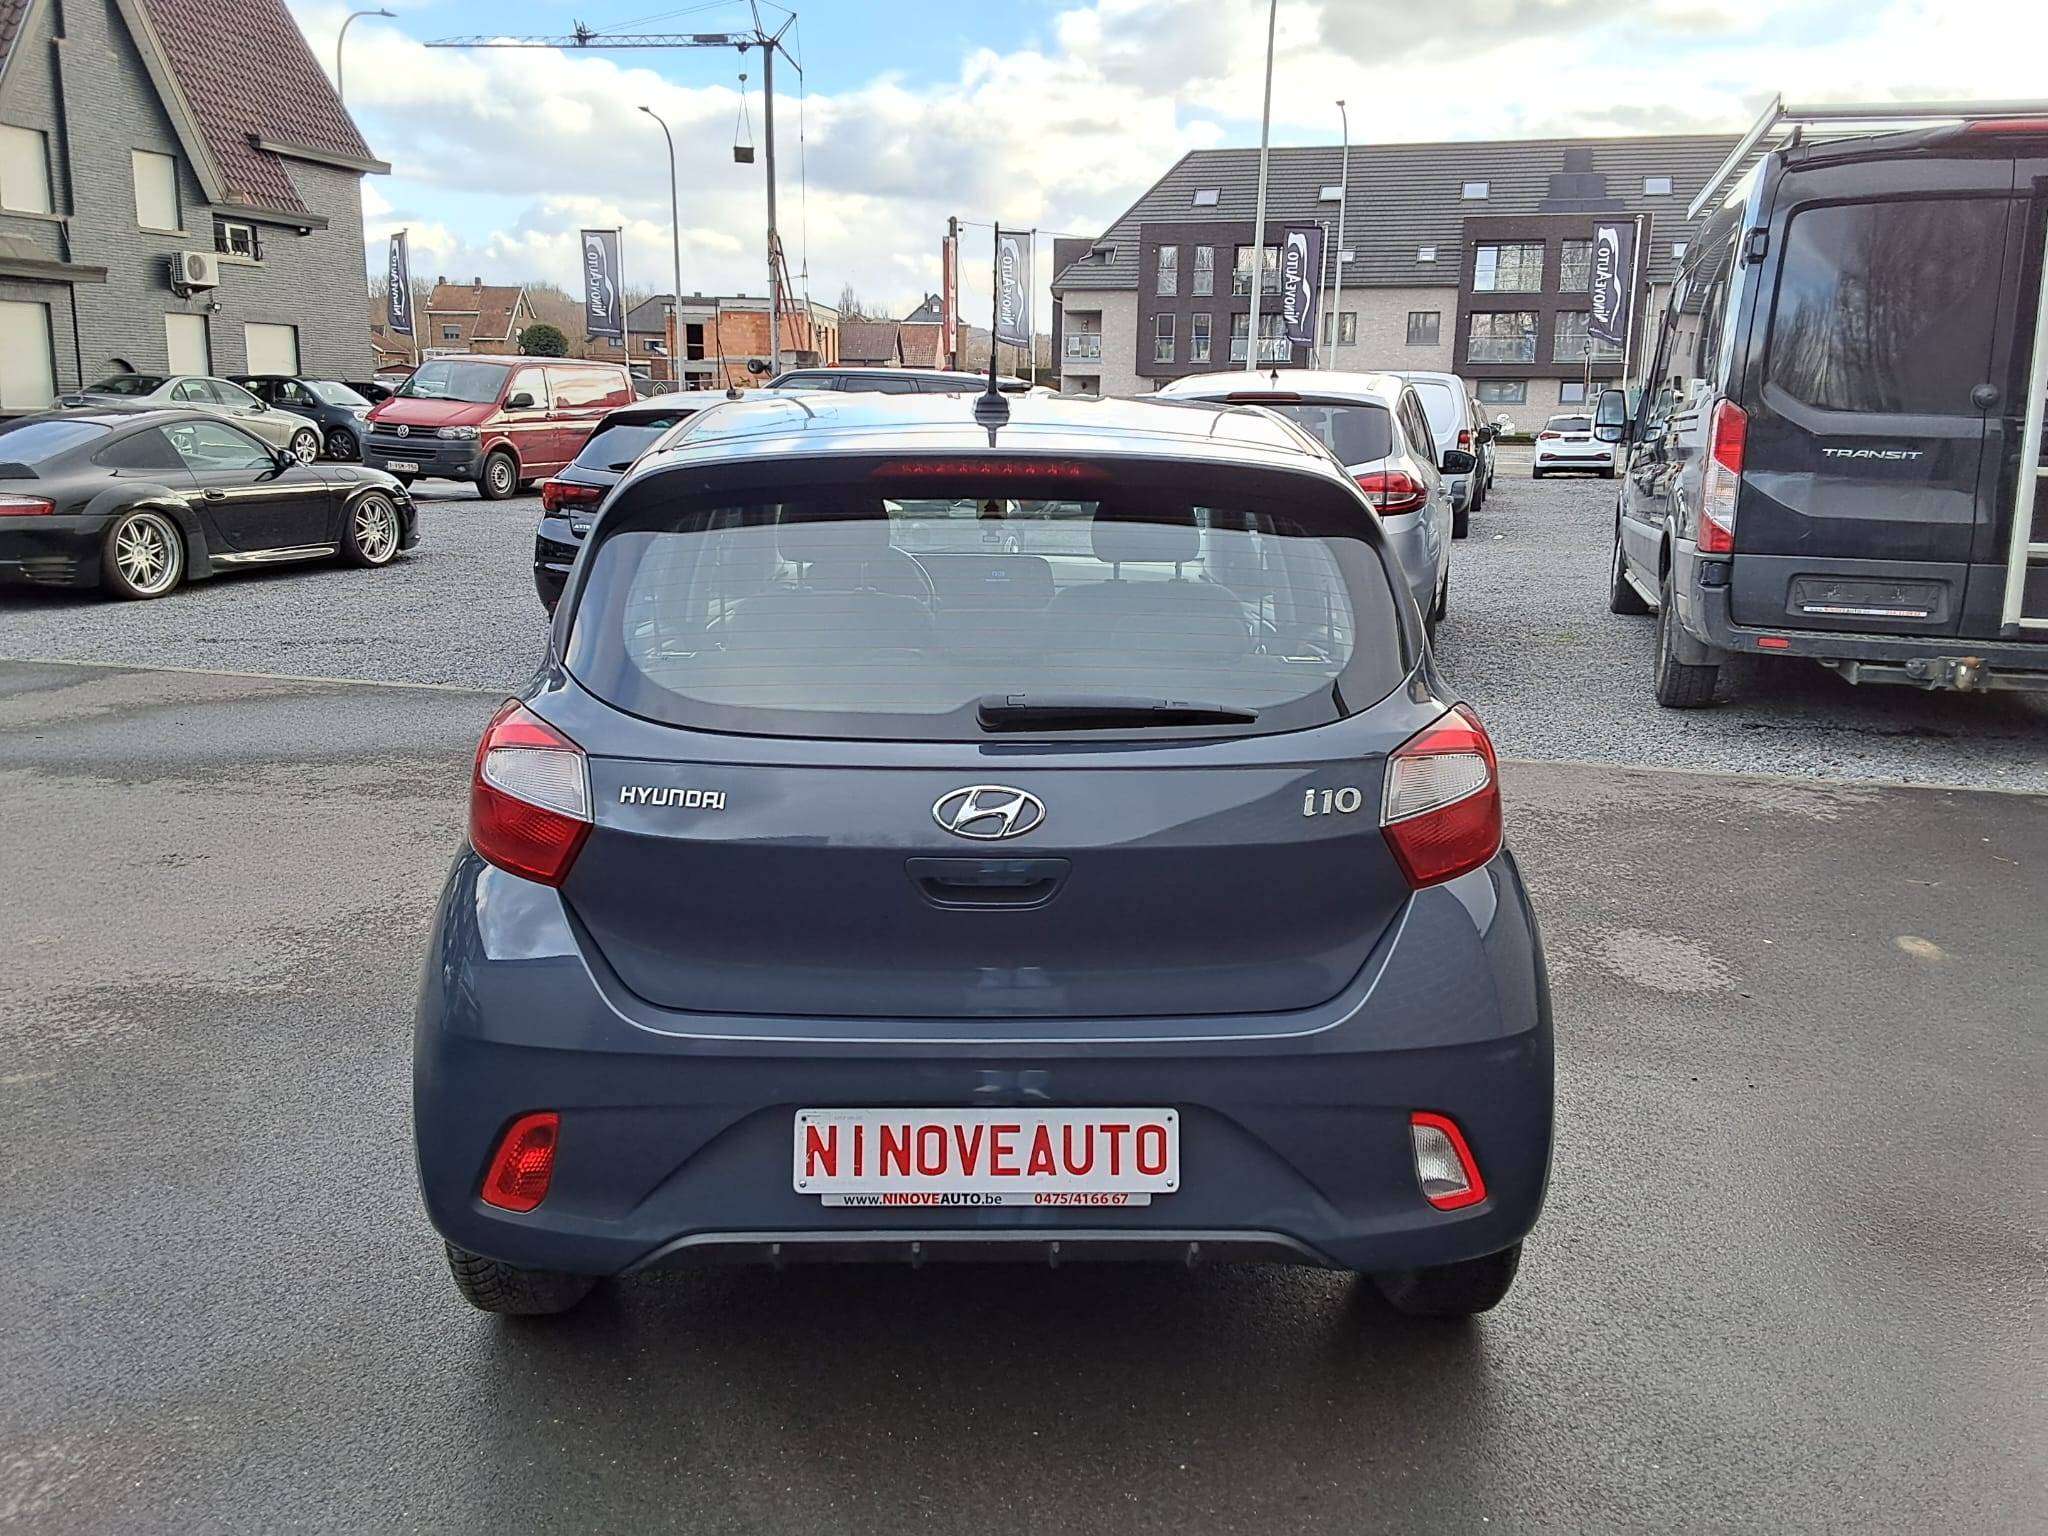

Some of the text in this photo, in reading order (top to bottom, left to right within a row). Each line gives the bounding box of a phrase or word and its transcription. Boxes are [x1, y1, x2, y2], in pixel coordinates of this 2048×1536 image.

[1821, 448, 1924, 460] TRANSIT
[620, 786, 726, 810] HYUNDAI
[1303, 787, 1362, 817] i10
[805, 1124, 1168, 1177] NINOVEAUTO
[843, 1192, 1003, 1206] www.NINOVEAUTO.be
